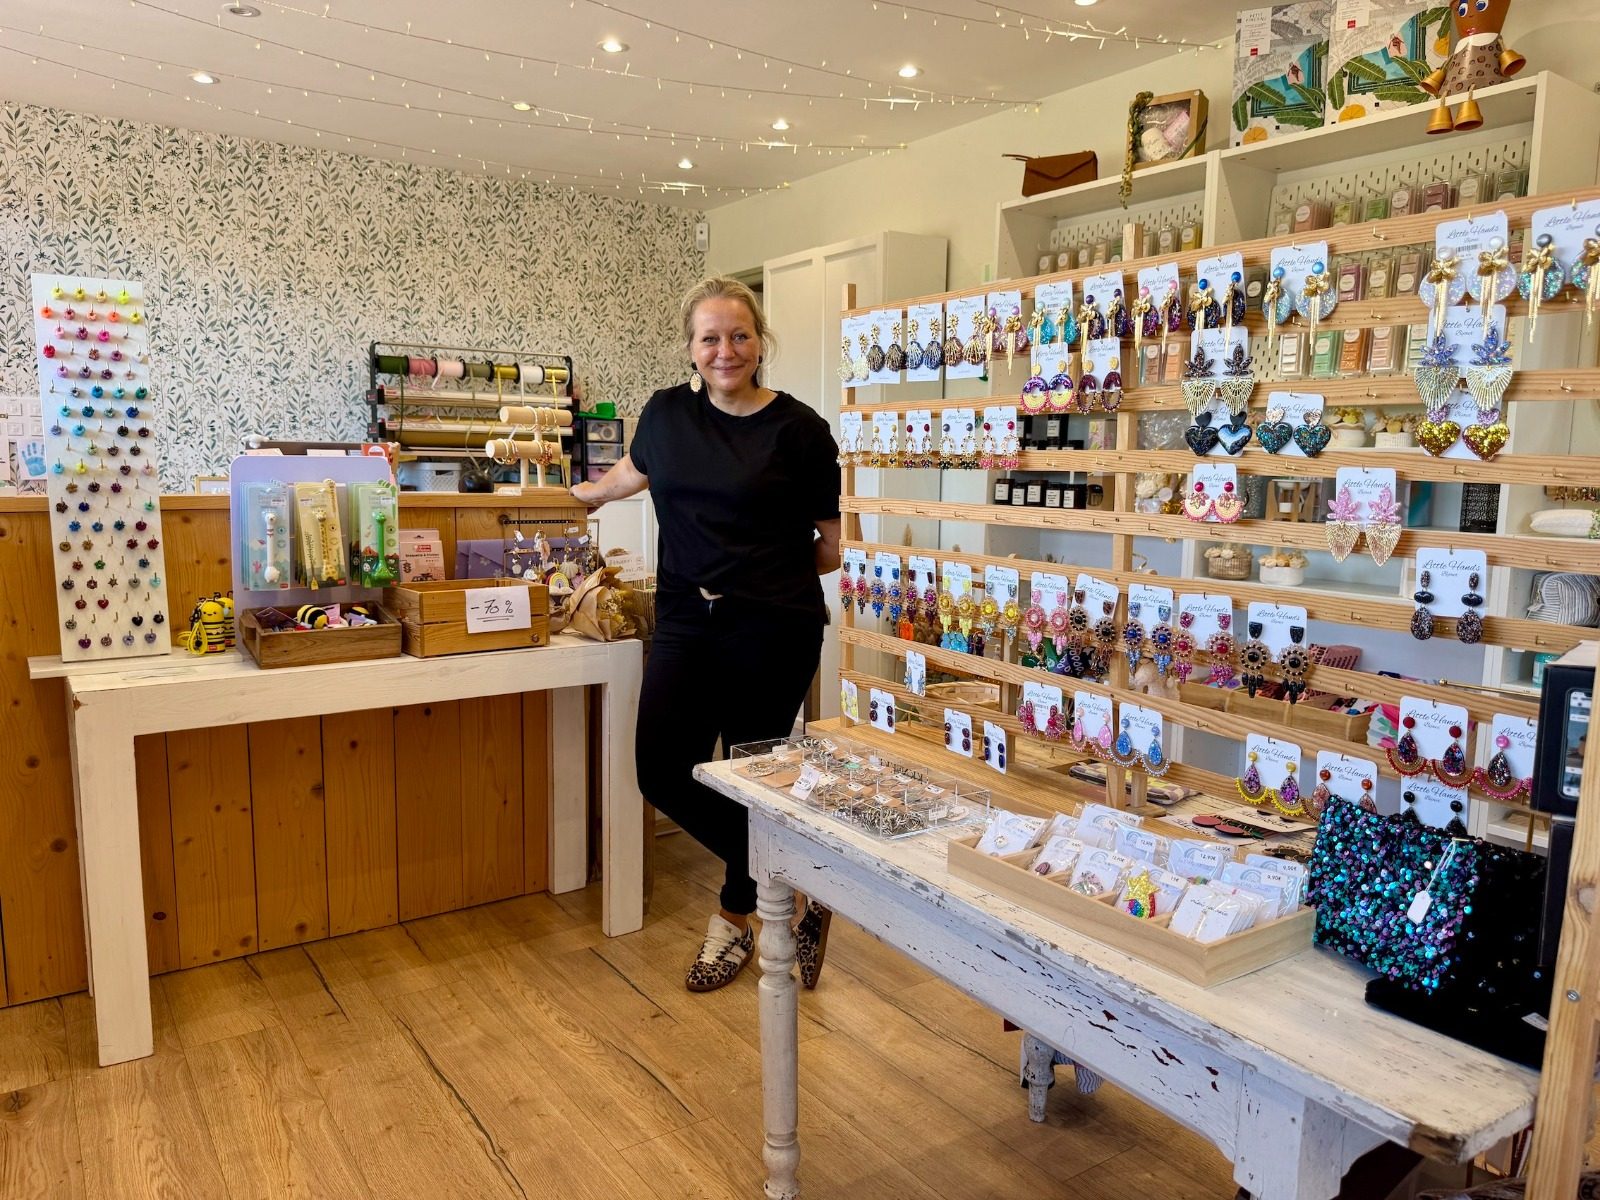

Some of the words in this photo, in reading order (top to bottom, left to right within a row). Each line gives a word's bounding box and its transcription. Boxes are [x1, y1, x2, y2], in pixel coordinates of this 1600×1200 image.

[1544, 215, 1572, 228] Little
[1446, 229, 1469, 240] Little
[1469, 224, 1499, 235] Hands
[1443, 319, 1462, 328] ittle
[1342, 479, 1364, 488] Little
[1364, 478, 1391, 489] Hands
[1423, 560, 1448, 570] Little
[1448, 560, 1481, 571] Hands
[1257, 609, 1275, 618] Little
[1275, 611, 1300, 621] Hands
[1407, 710, 1429, 720] Little
[1430, 713, 1462, 727] Hands
[1499, 727, 1525, 739] Little
[1251, 744, 1270, 754] Little
[1270, 748, 1296, 761] Hands
[1322, 762, 1344, 773] Little
[1343, 765, 1372, 779] Hands
[1407, 782, 1430, 794] Little
[1430, 786, 1462, 800] Hands
